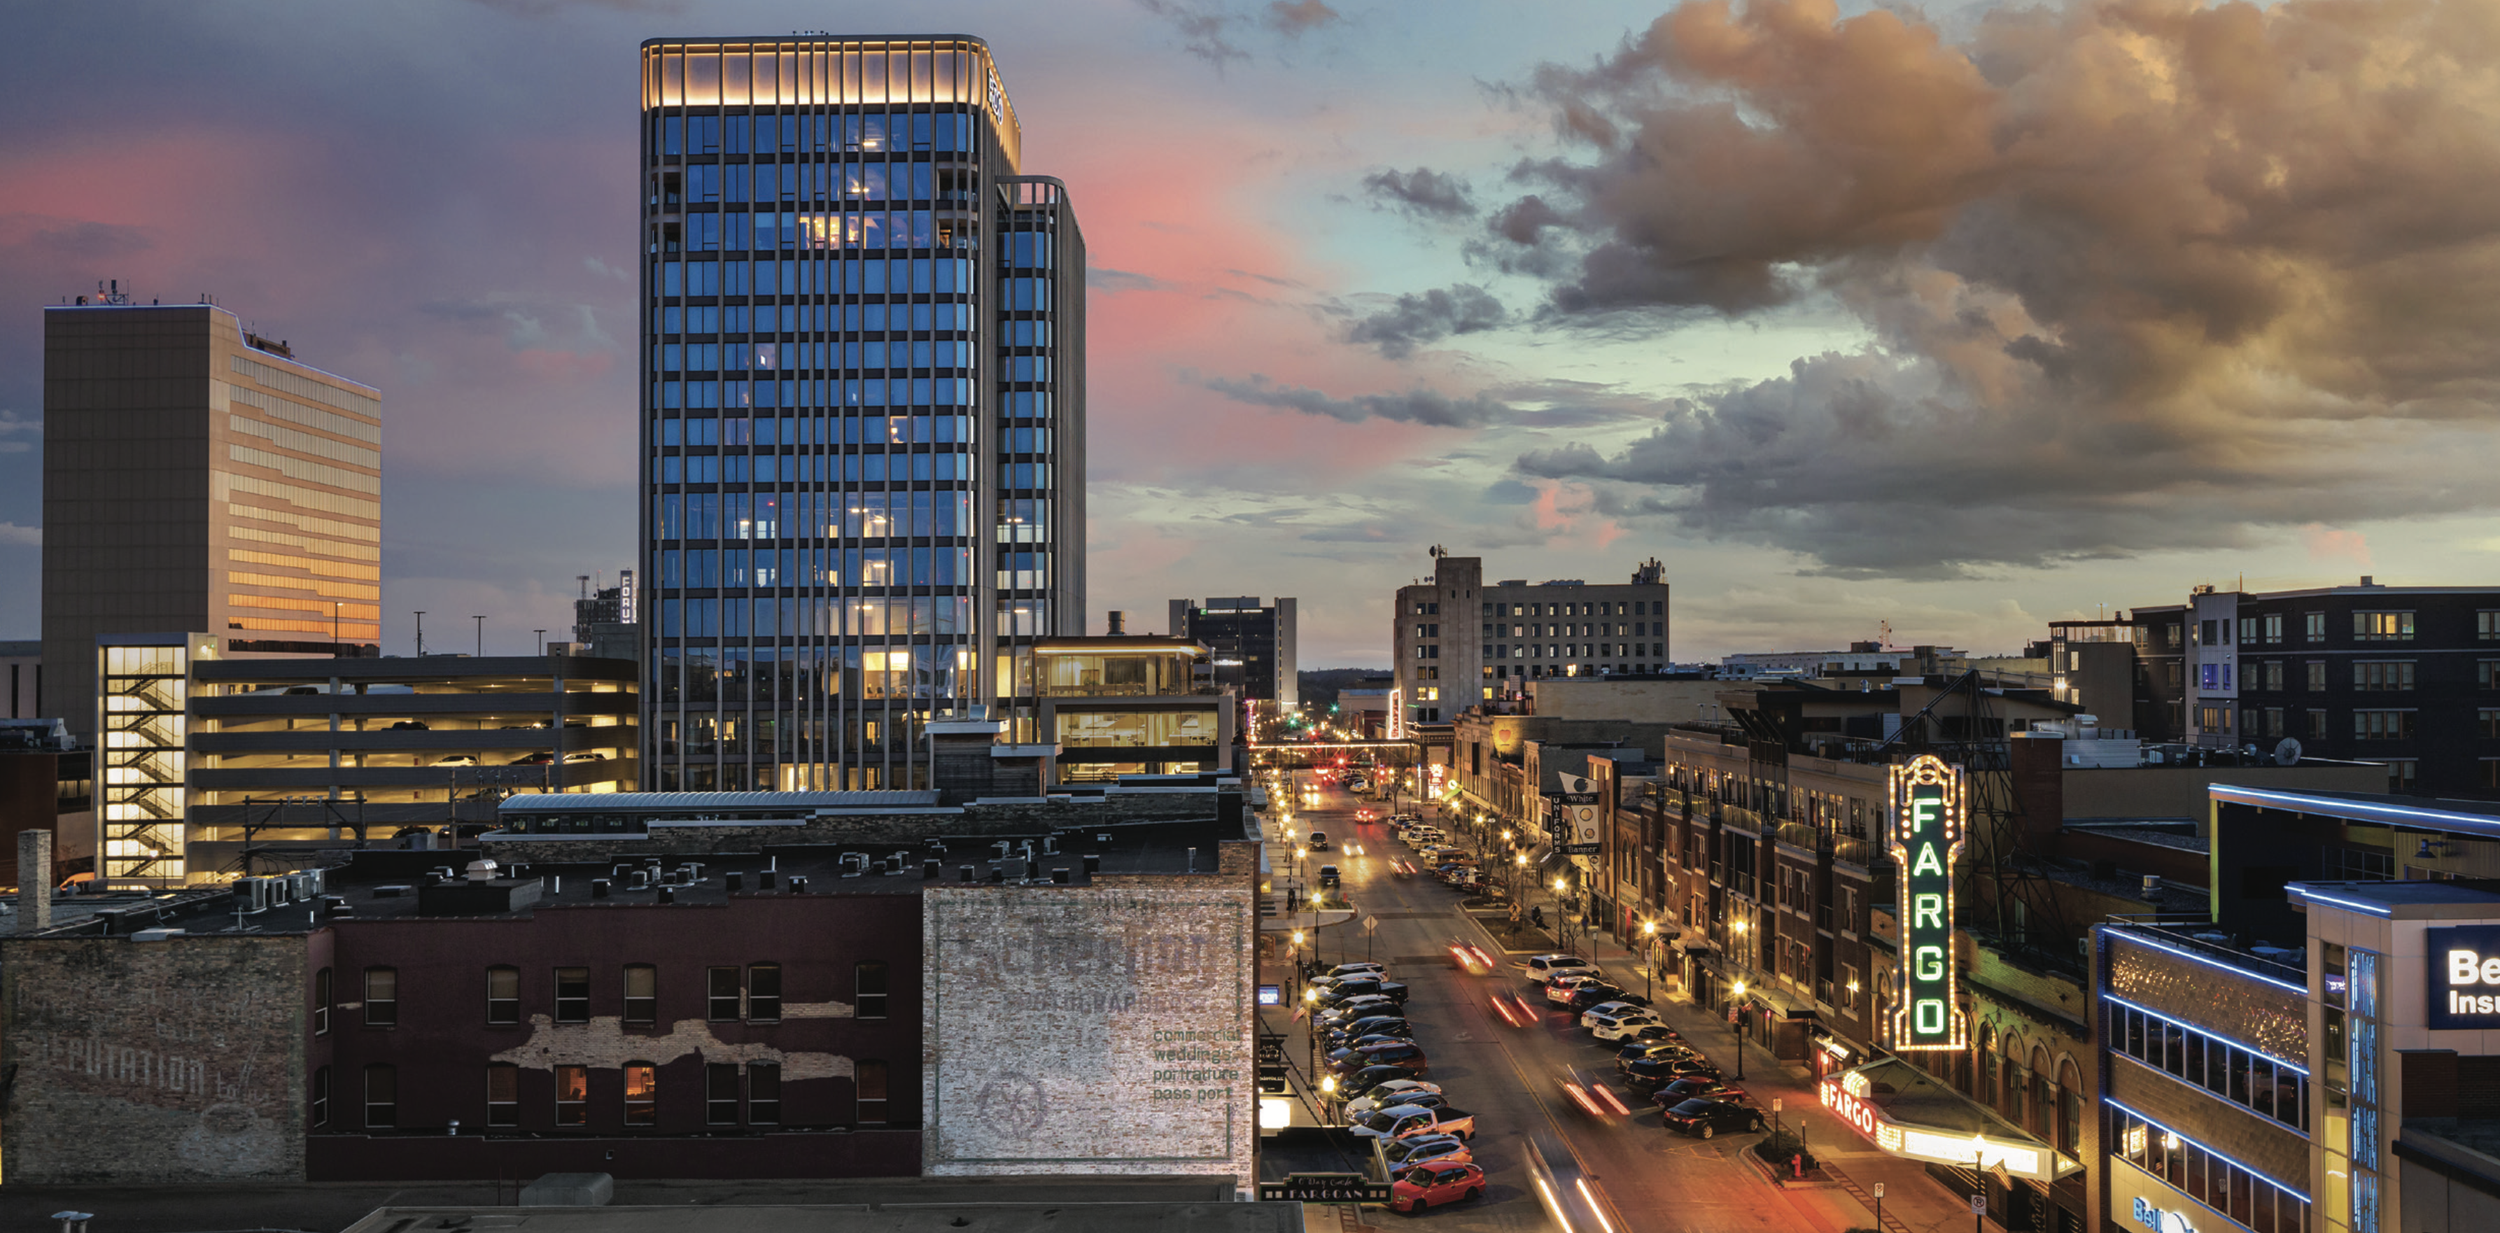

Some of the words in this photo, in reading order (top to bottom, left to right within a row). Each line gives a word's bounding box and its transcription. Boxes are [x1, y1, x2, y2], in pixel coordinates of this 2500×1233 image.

[1566, 795, 1594, 803] White
[1553, 797, 1561, 853] UNIFORMS
[1912, 797, 1944, 1035] FARGO
[1153, 1027, 1242, 1042] commercial
[1153, 1088, 1192, 1104] pass
[1197, 1087, 1233, 1104] port
[1829, 1083, 1873, 1133] FARGO
[1289, 1189, 1363, 1200] FARGOAN
